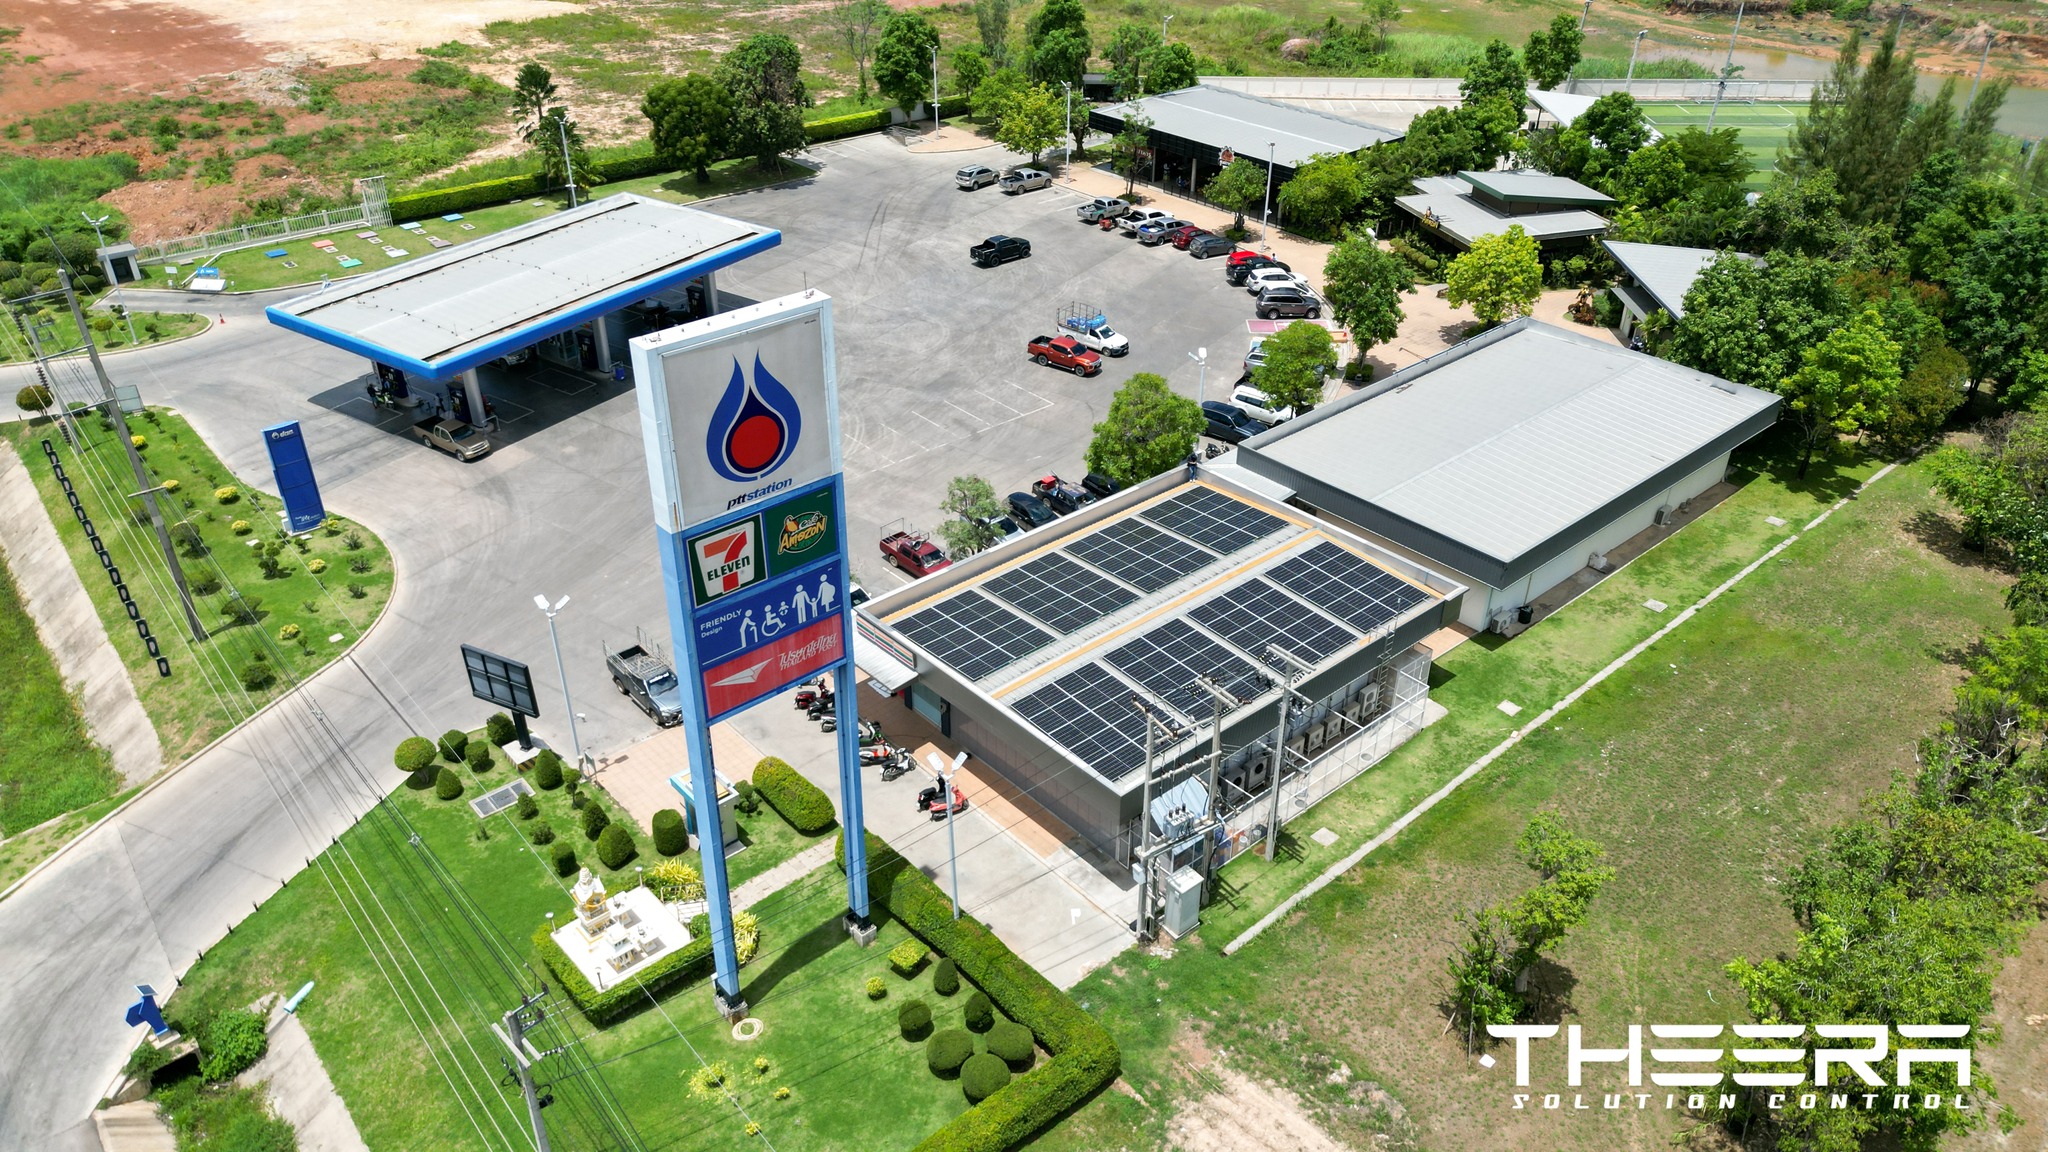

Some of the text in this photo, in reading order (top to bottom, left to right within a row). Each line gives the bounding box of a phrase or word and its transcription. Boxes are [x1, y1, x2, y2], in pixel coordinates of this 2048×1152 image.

[703, 530, 748, 593] 7
[700, 609, 742, 631] FRIENDLY
[701, 626, 723, 638] Design
